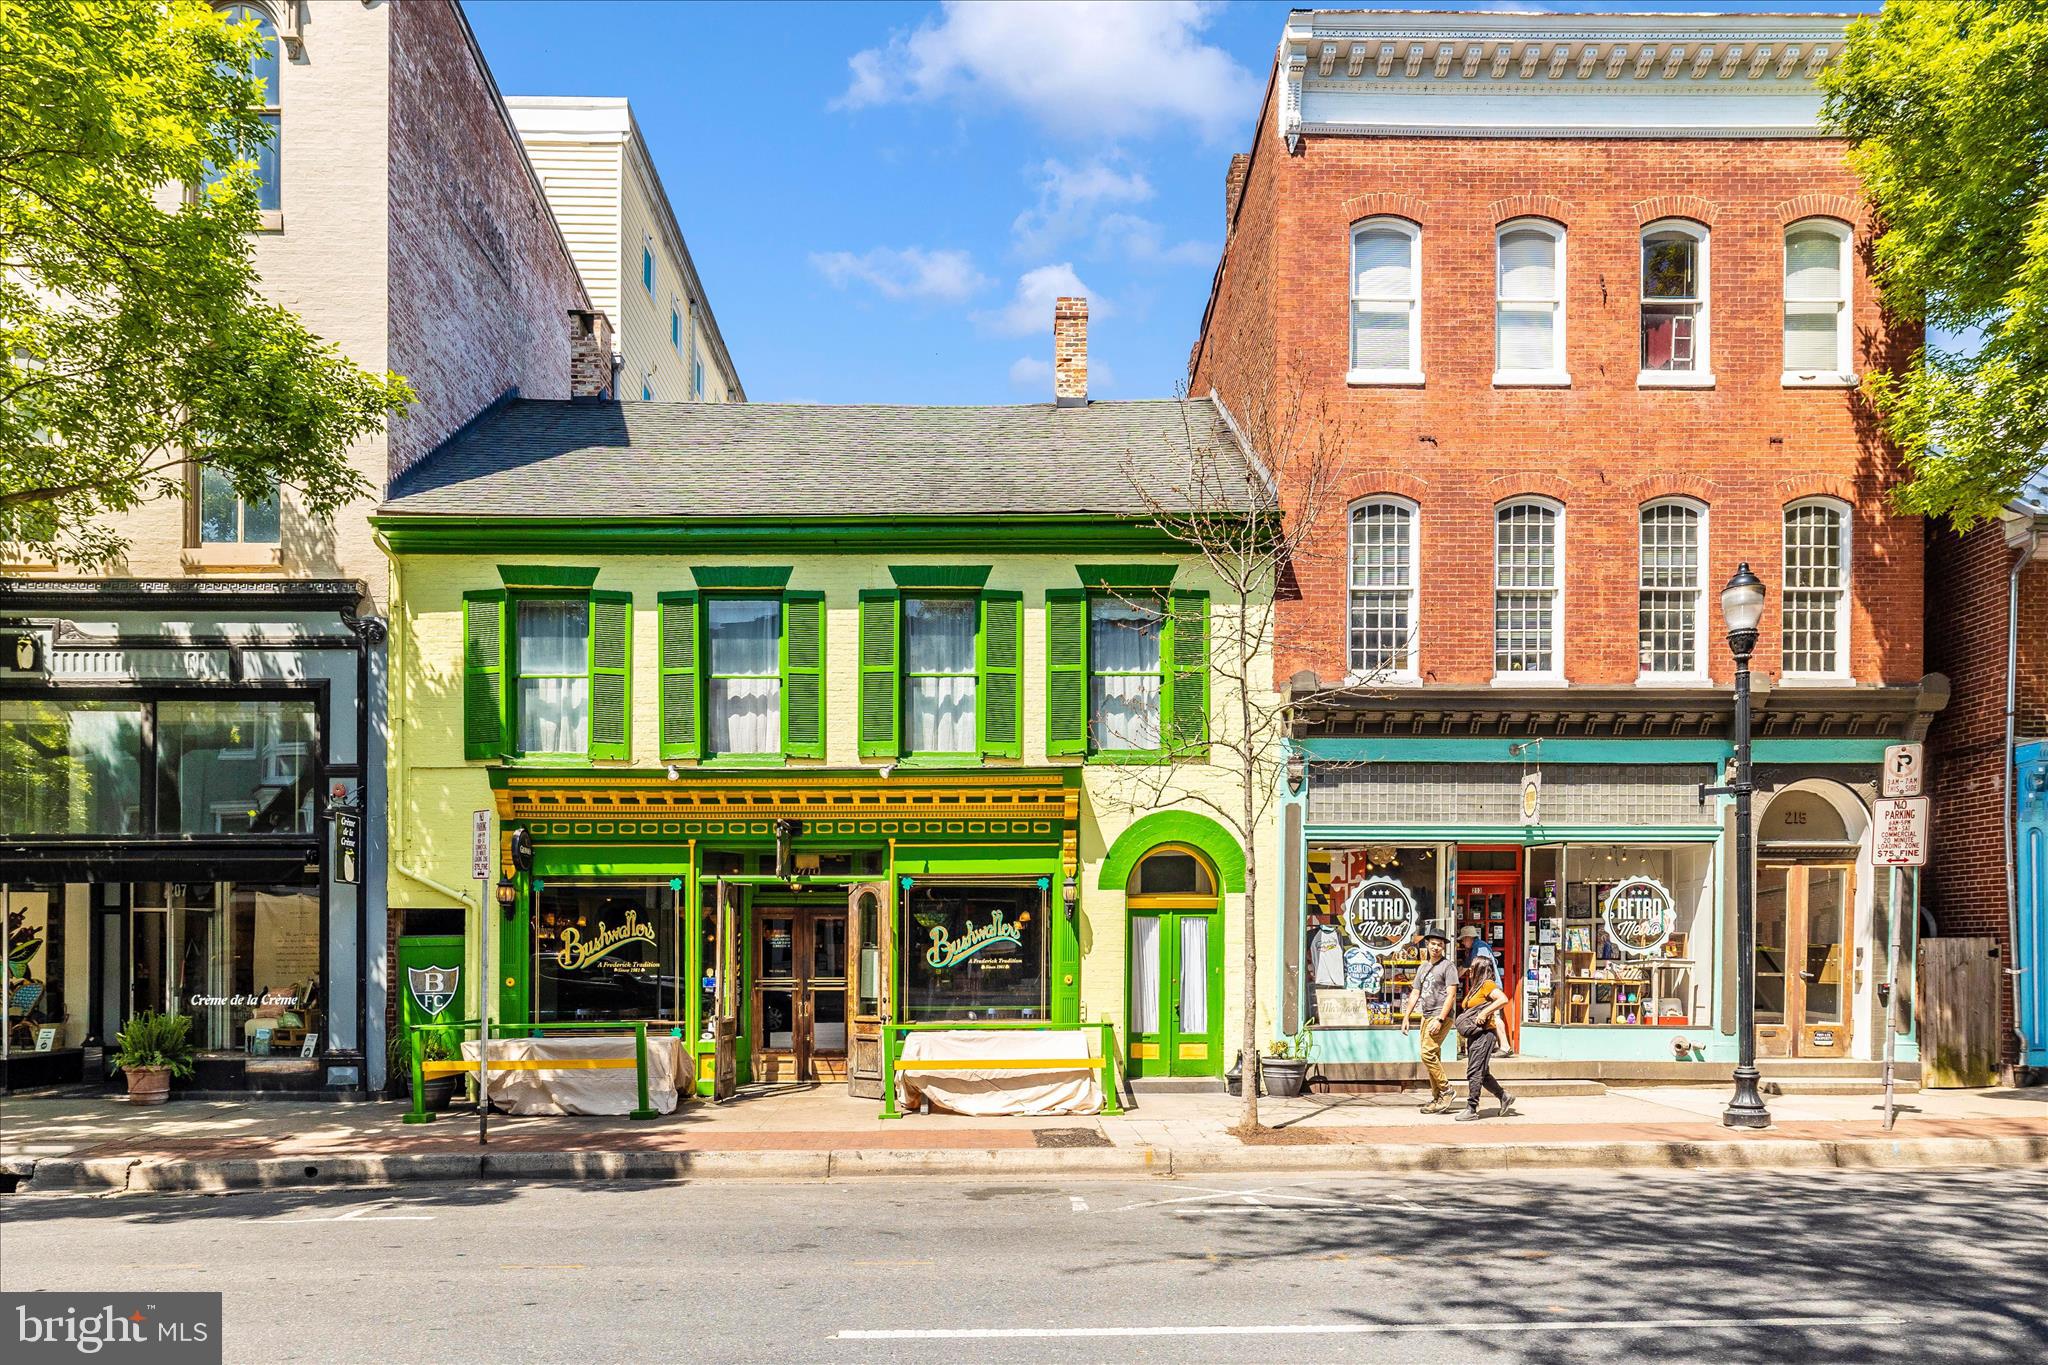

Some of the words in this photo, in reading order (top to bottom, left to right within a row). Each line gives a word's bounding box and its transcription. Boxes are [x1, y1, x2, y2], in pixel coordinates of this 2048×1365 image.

[1894, 801, 1907, 809] NO
[1784, 811, 1807, 825] 215
[1885, 809, 1915, 819] PARKING
[340, 816, 356, 828] Crème
[340, 837, 356, 848] Crème
[1877, 850, 1895, 858] $75
[1900, 849, 1919, 857] FINE
[1358, 897, 1404, 920] RETRO
[1617, 897, 1662, 920] RETRO
[1358, 920, 1408, 941] Metro
[424, 972, 445, 992] B
[190, 993, 229, 1006] Crème
[230, 994, 245, 1006] de
[246, 994, 259, 1006] la
[261, 993, 298, 1006] Crème
[424, 995, 444, 1007] FC
